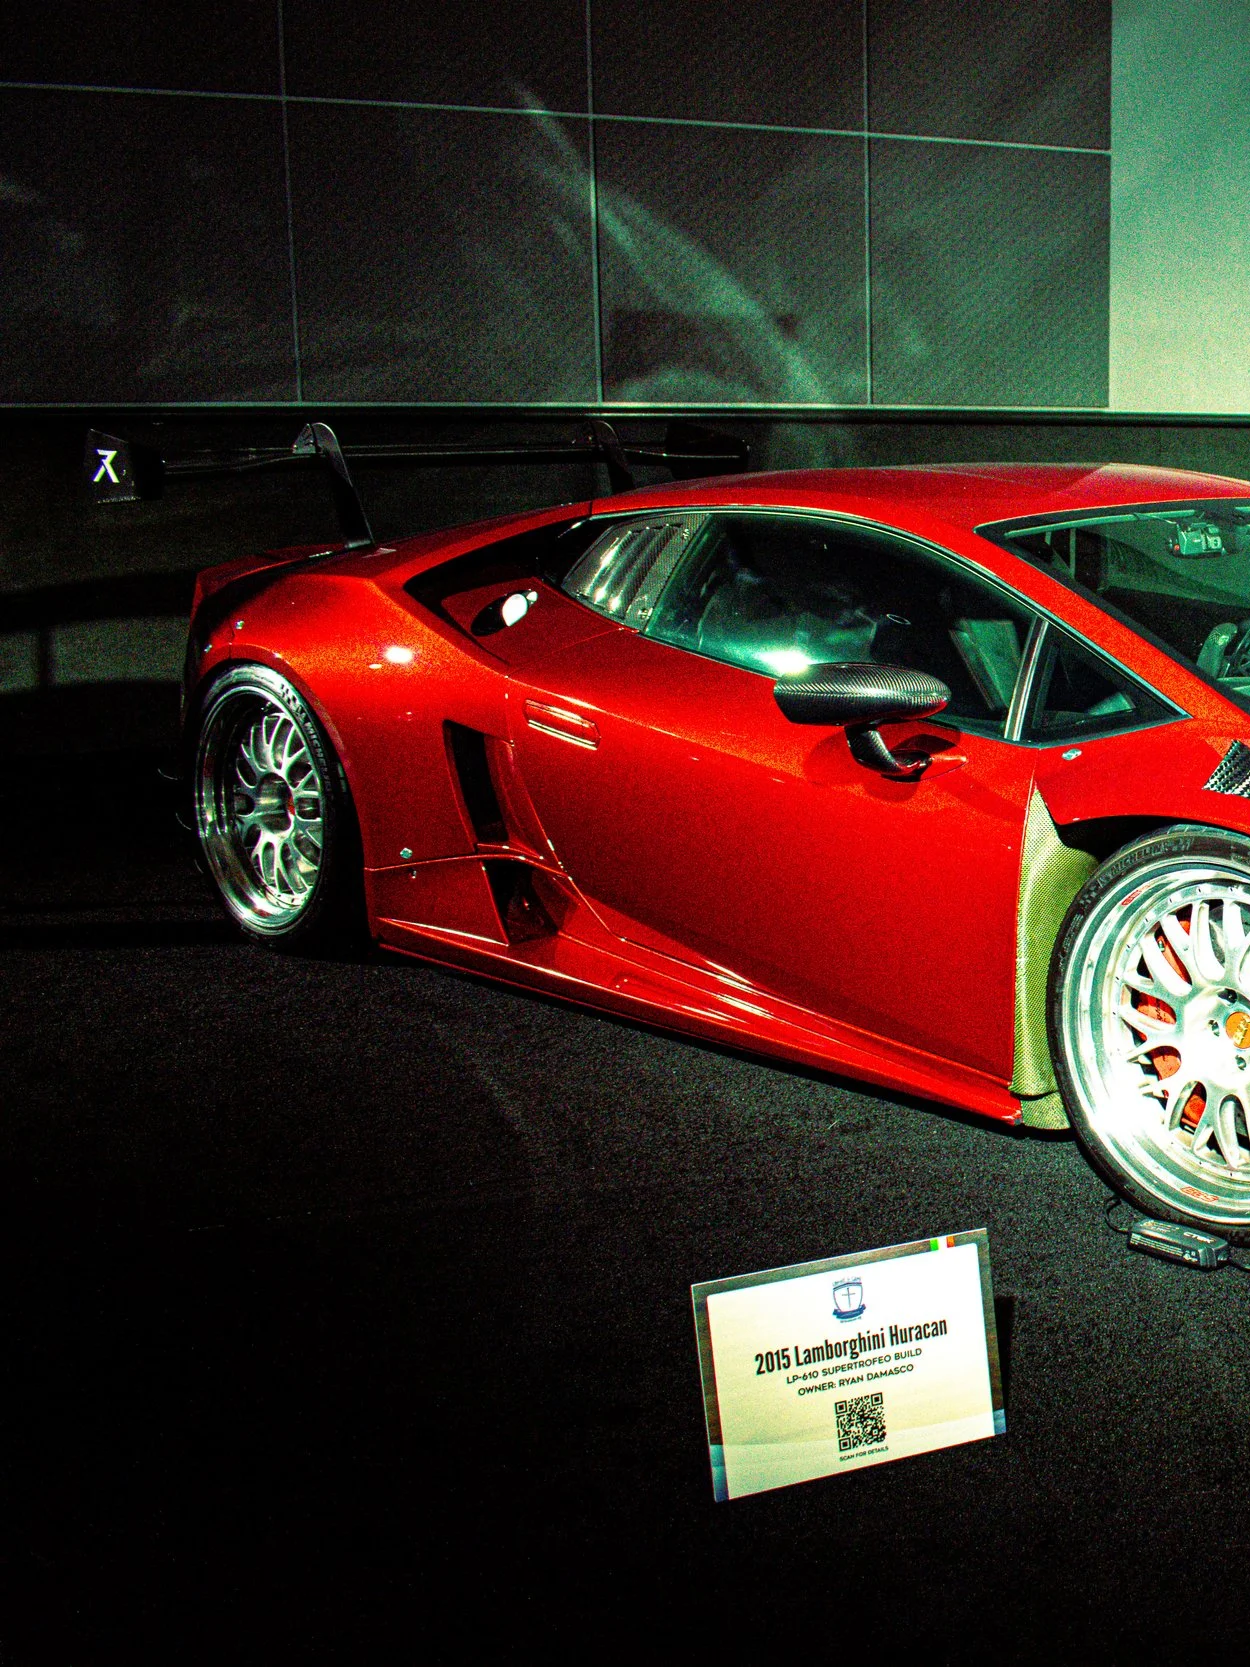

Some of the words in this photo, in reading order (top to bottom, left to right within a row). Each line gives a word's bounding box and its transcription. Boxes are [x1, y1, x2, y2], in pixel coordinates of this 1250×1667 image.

[755, 1348, 791, 1376] 2015
[795, 1327, 886, 1367] Lamborghini
[889, 1319, 948, 1347] Huracan
[786, 1370, 819, 1385] LP-610
[821, 1355, 892, 1378] SUPERTROFEO
[894, 1348, 923, 1361] BUILD
[798, 1381, 837, 1396] OWNER:
[838, 1375, 864, 1388] RYAN
[866, 1364, 915, 1381] DAMASCO
[839, 1453, 855, 1462] SCAN
[856, 1450, 867, 1458] FOR
[868, 1445, 889, 1455] DETAILS
